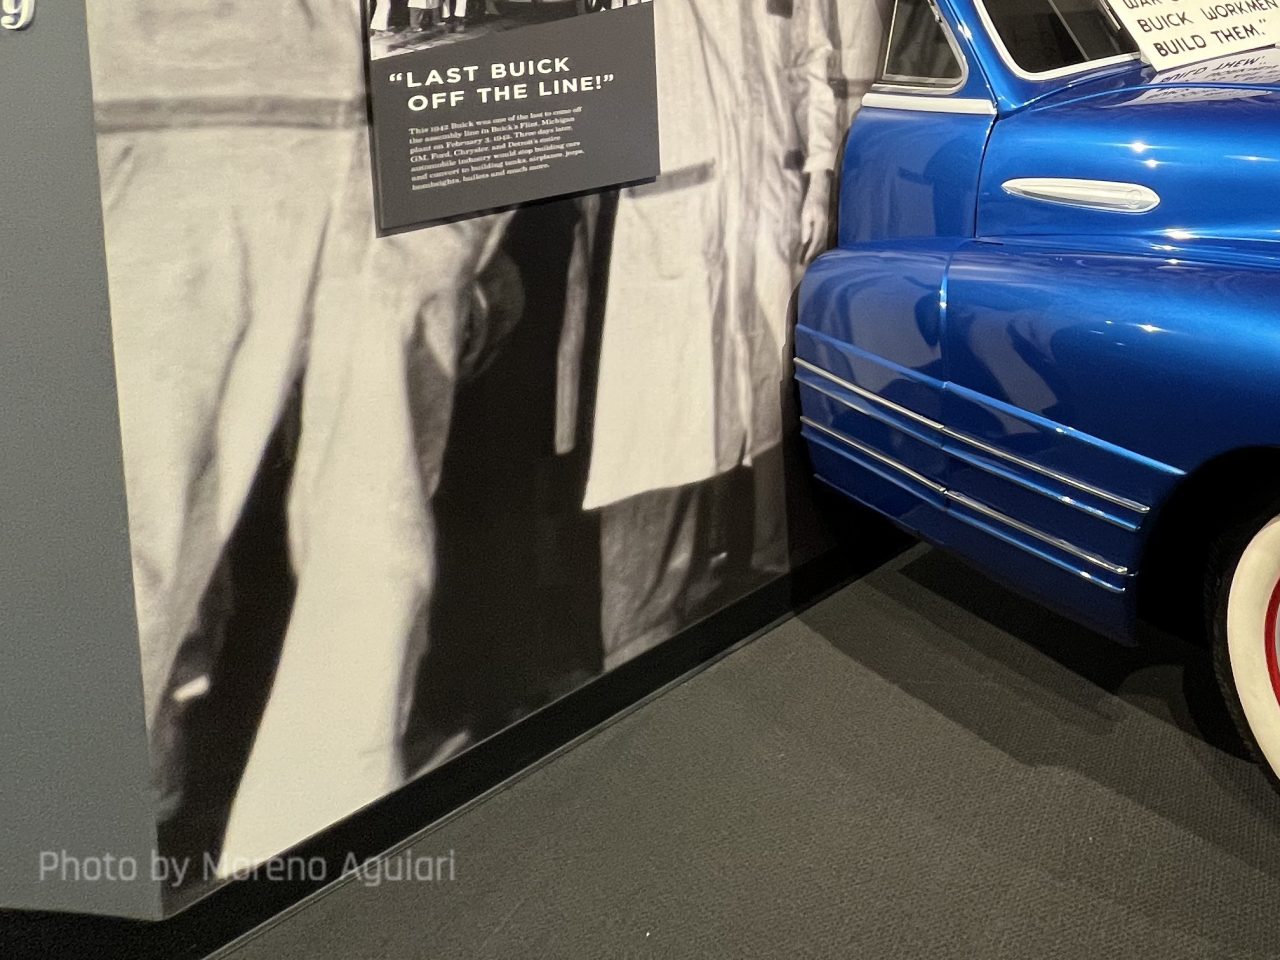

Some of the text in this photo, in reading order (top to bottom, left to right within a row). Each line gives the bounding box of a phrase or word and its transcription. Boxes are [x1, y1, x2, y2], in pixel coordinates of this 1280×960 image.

[1137, 11, 1194, 33] BUICK
[1152, 34, 1207, 57] BUILD
[388, 57, 570, 88] “LAST BUICK
[407, 74, 615, 112] OFF THE LINE!”
[408, 127, 429, 135] This
[451, 121, 474, 129] Buick
[424, 131, 463, 142] assembly
[541, 117, 575, 126] Michigan
[409, 145, 432, 155] plant
[446, 138, 483, 148] February
[513, 130, 537, 138] Three
[411, 160, 457, 172] automobile
[458, 155, 491, 165] industry
[493, 150, 516, 158] would
[534, 144, 565, 152] building
[411, 173, 428, 181] and
[470, 162, 504, 172] building
[490, 169, 505, 177] and
